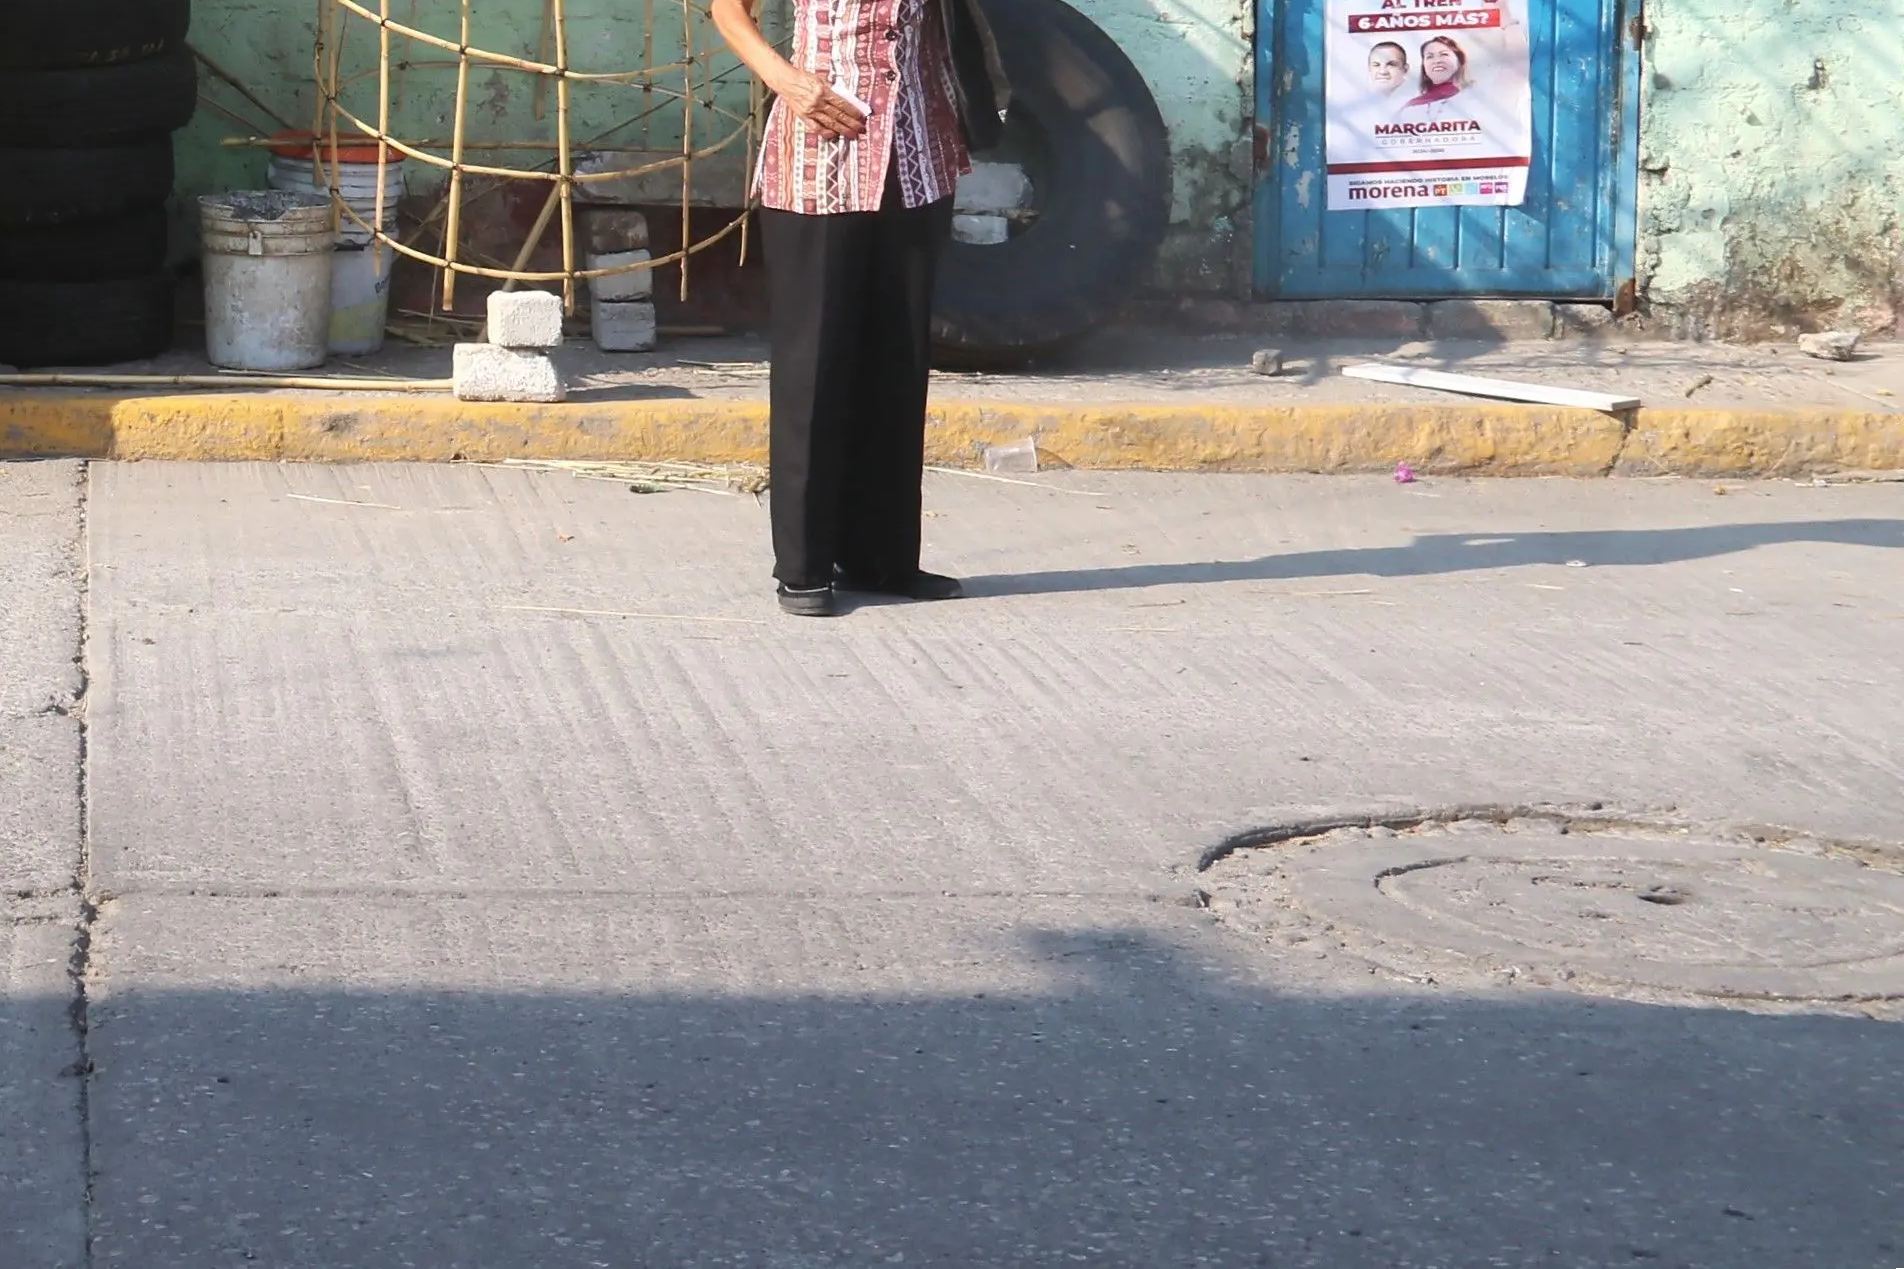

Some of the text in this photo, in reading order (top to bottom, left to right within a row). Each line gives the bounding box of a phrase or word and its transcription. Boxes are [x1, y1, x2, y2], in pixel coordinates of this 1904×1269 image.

[1358, 11, 1490, 29] 6 AÑOS MÁS?
[1375, 120, 1481, 136] MARGARITA
[1381, 136, 1476, 146] GOBERNADORA
[1348, 185, 1429, 200] morena
